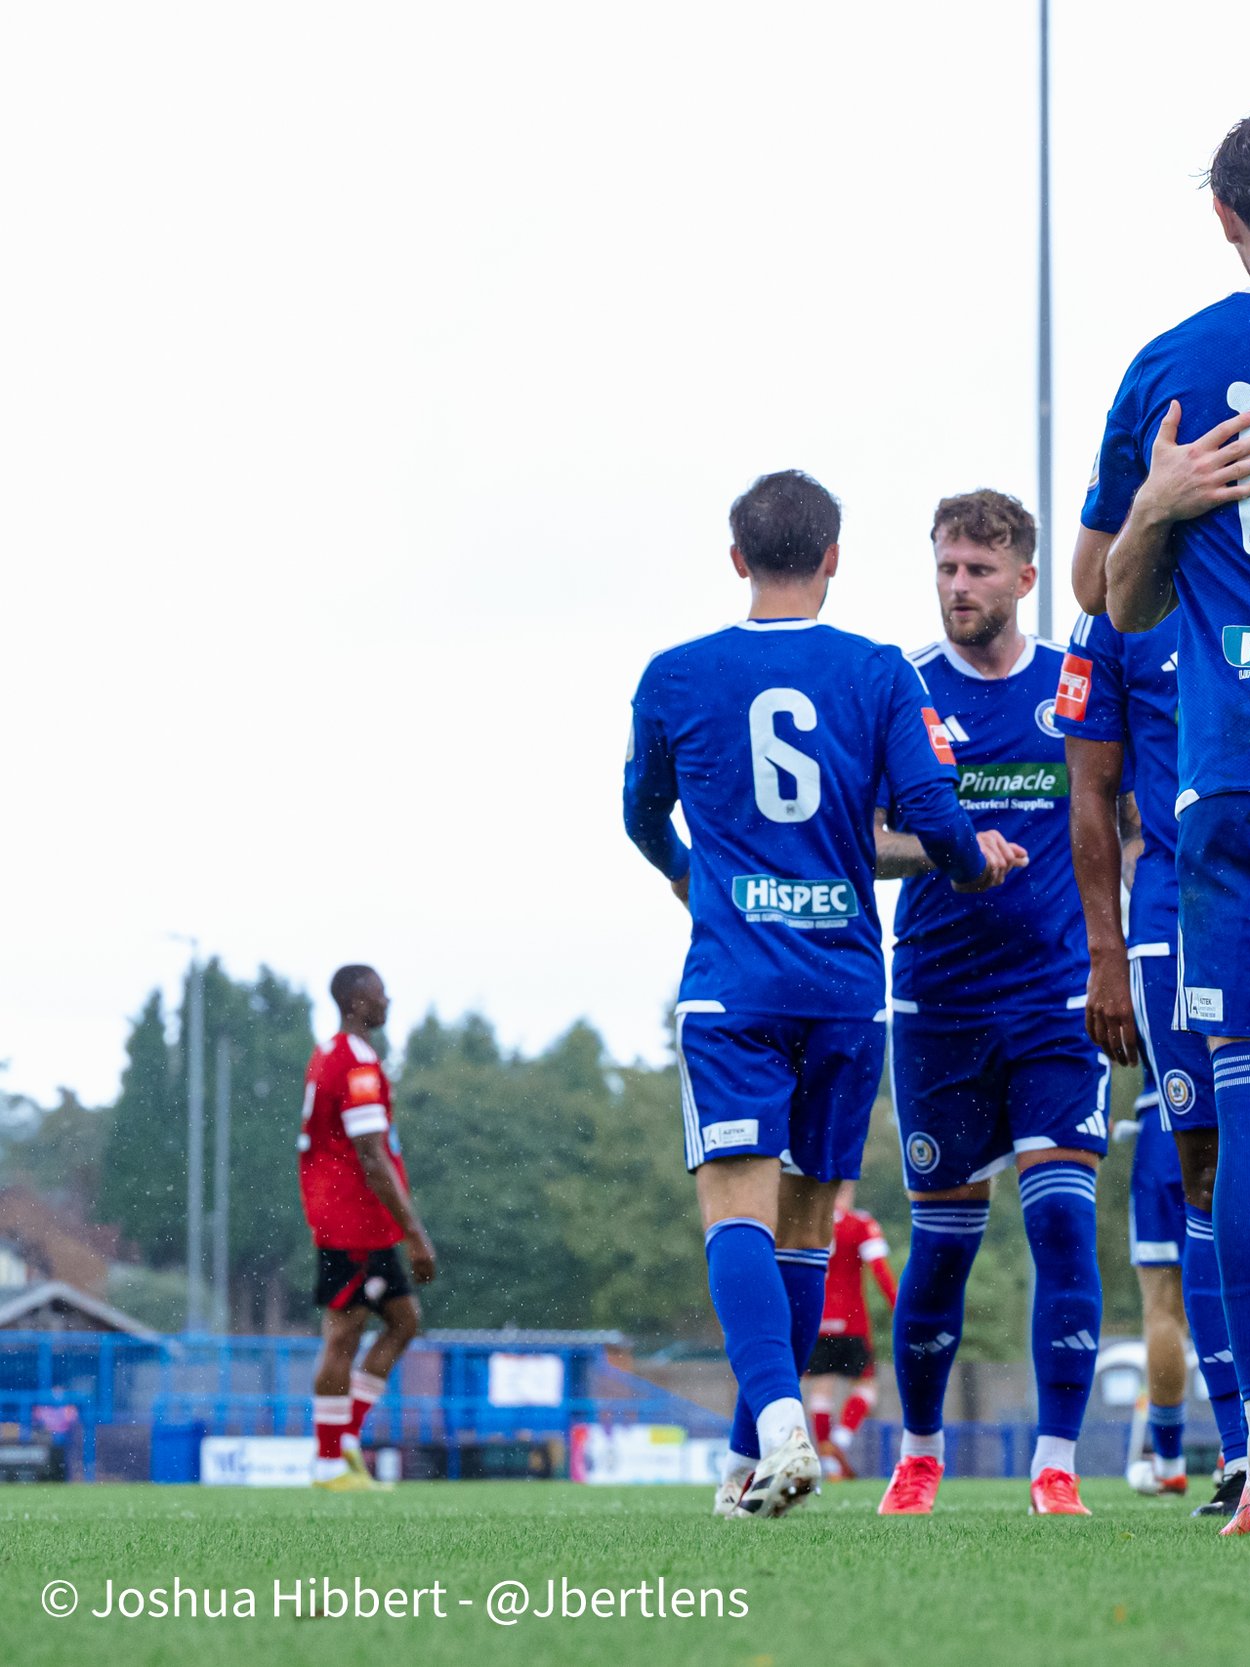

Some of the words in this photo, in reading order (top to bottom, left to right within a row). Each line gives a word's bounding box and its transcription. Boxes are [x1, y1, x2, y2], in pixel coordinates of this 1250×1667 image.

[749, 687, 821, 823] 6
[960, 769, 1056, 792] Pinnacle
[1010, 798, 1055, 812] Supplies
